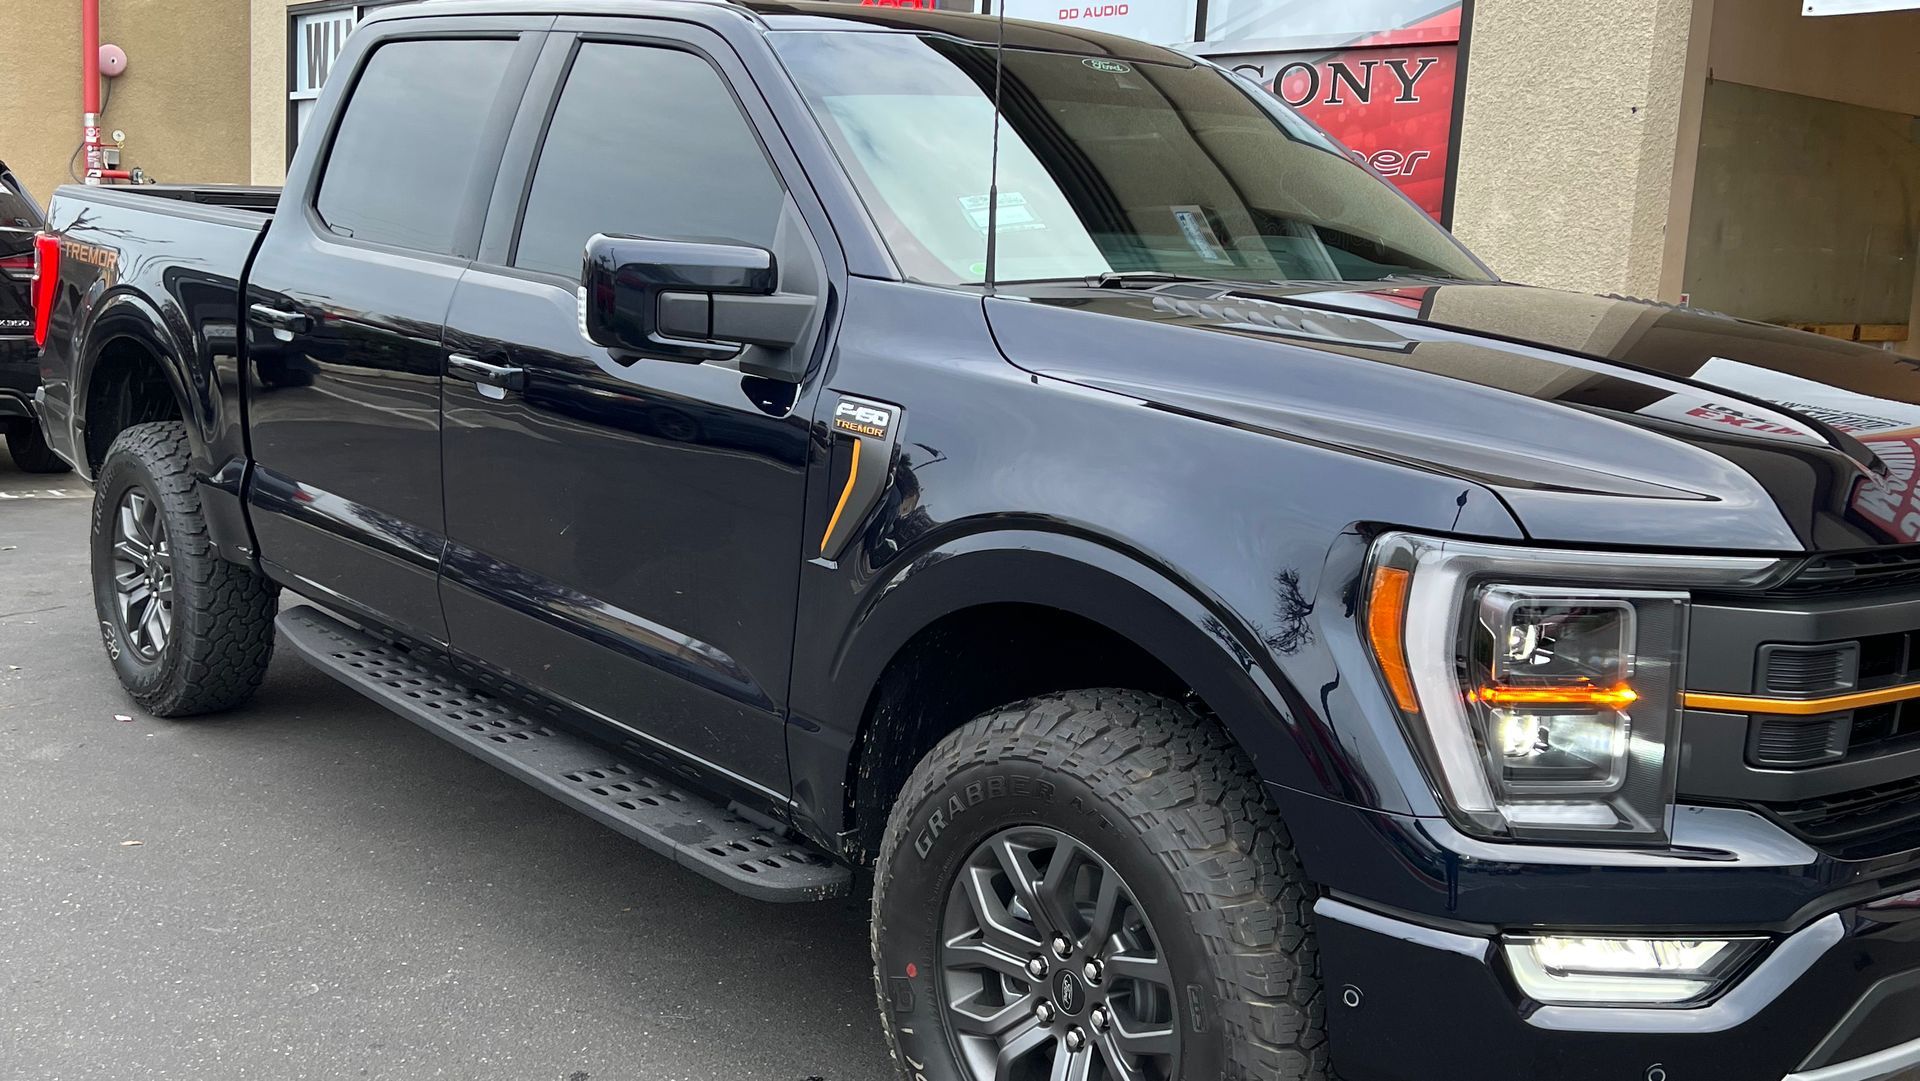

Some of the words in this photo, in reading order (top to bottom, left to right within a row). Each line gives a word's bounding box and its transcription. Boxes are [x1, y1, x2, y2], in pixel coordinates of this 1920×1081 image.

[1059, 9, 1078, 19] DD
[1083, 4, 1128, 18] AUDIO
[306, 19, 352, 89] WI
[64, 241, 117, 270] TREMOR
[836, 418, 884, 438] TREMOR
[914, 774, 1057, 859] GRABBER
